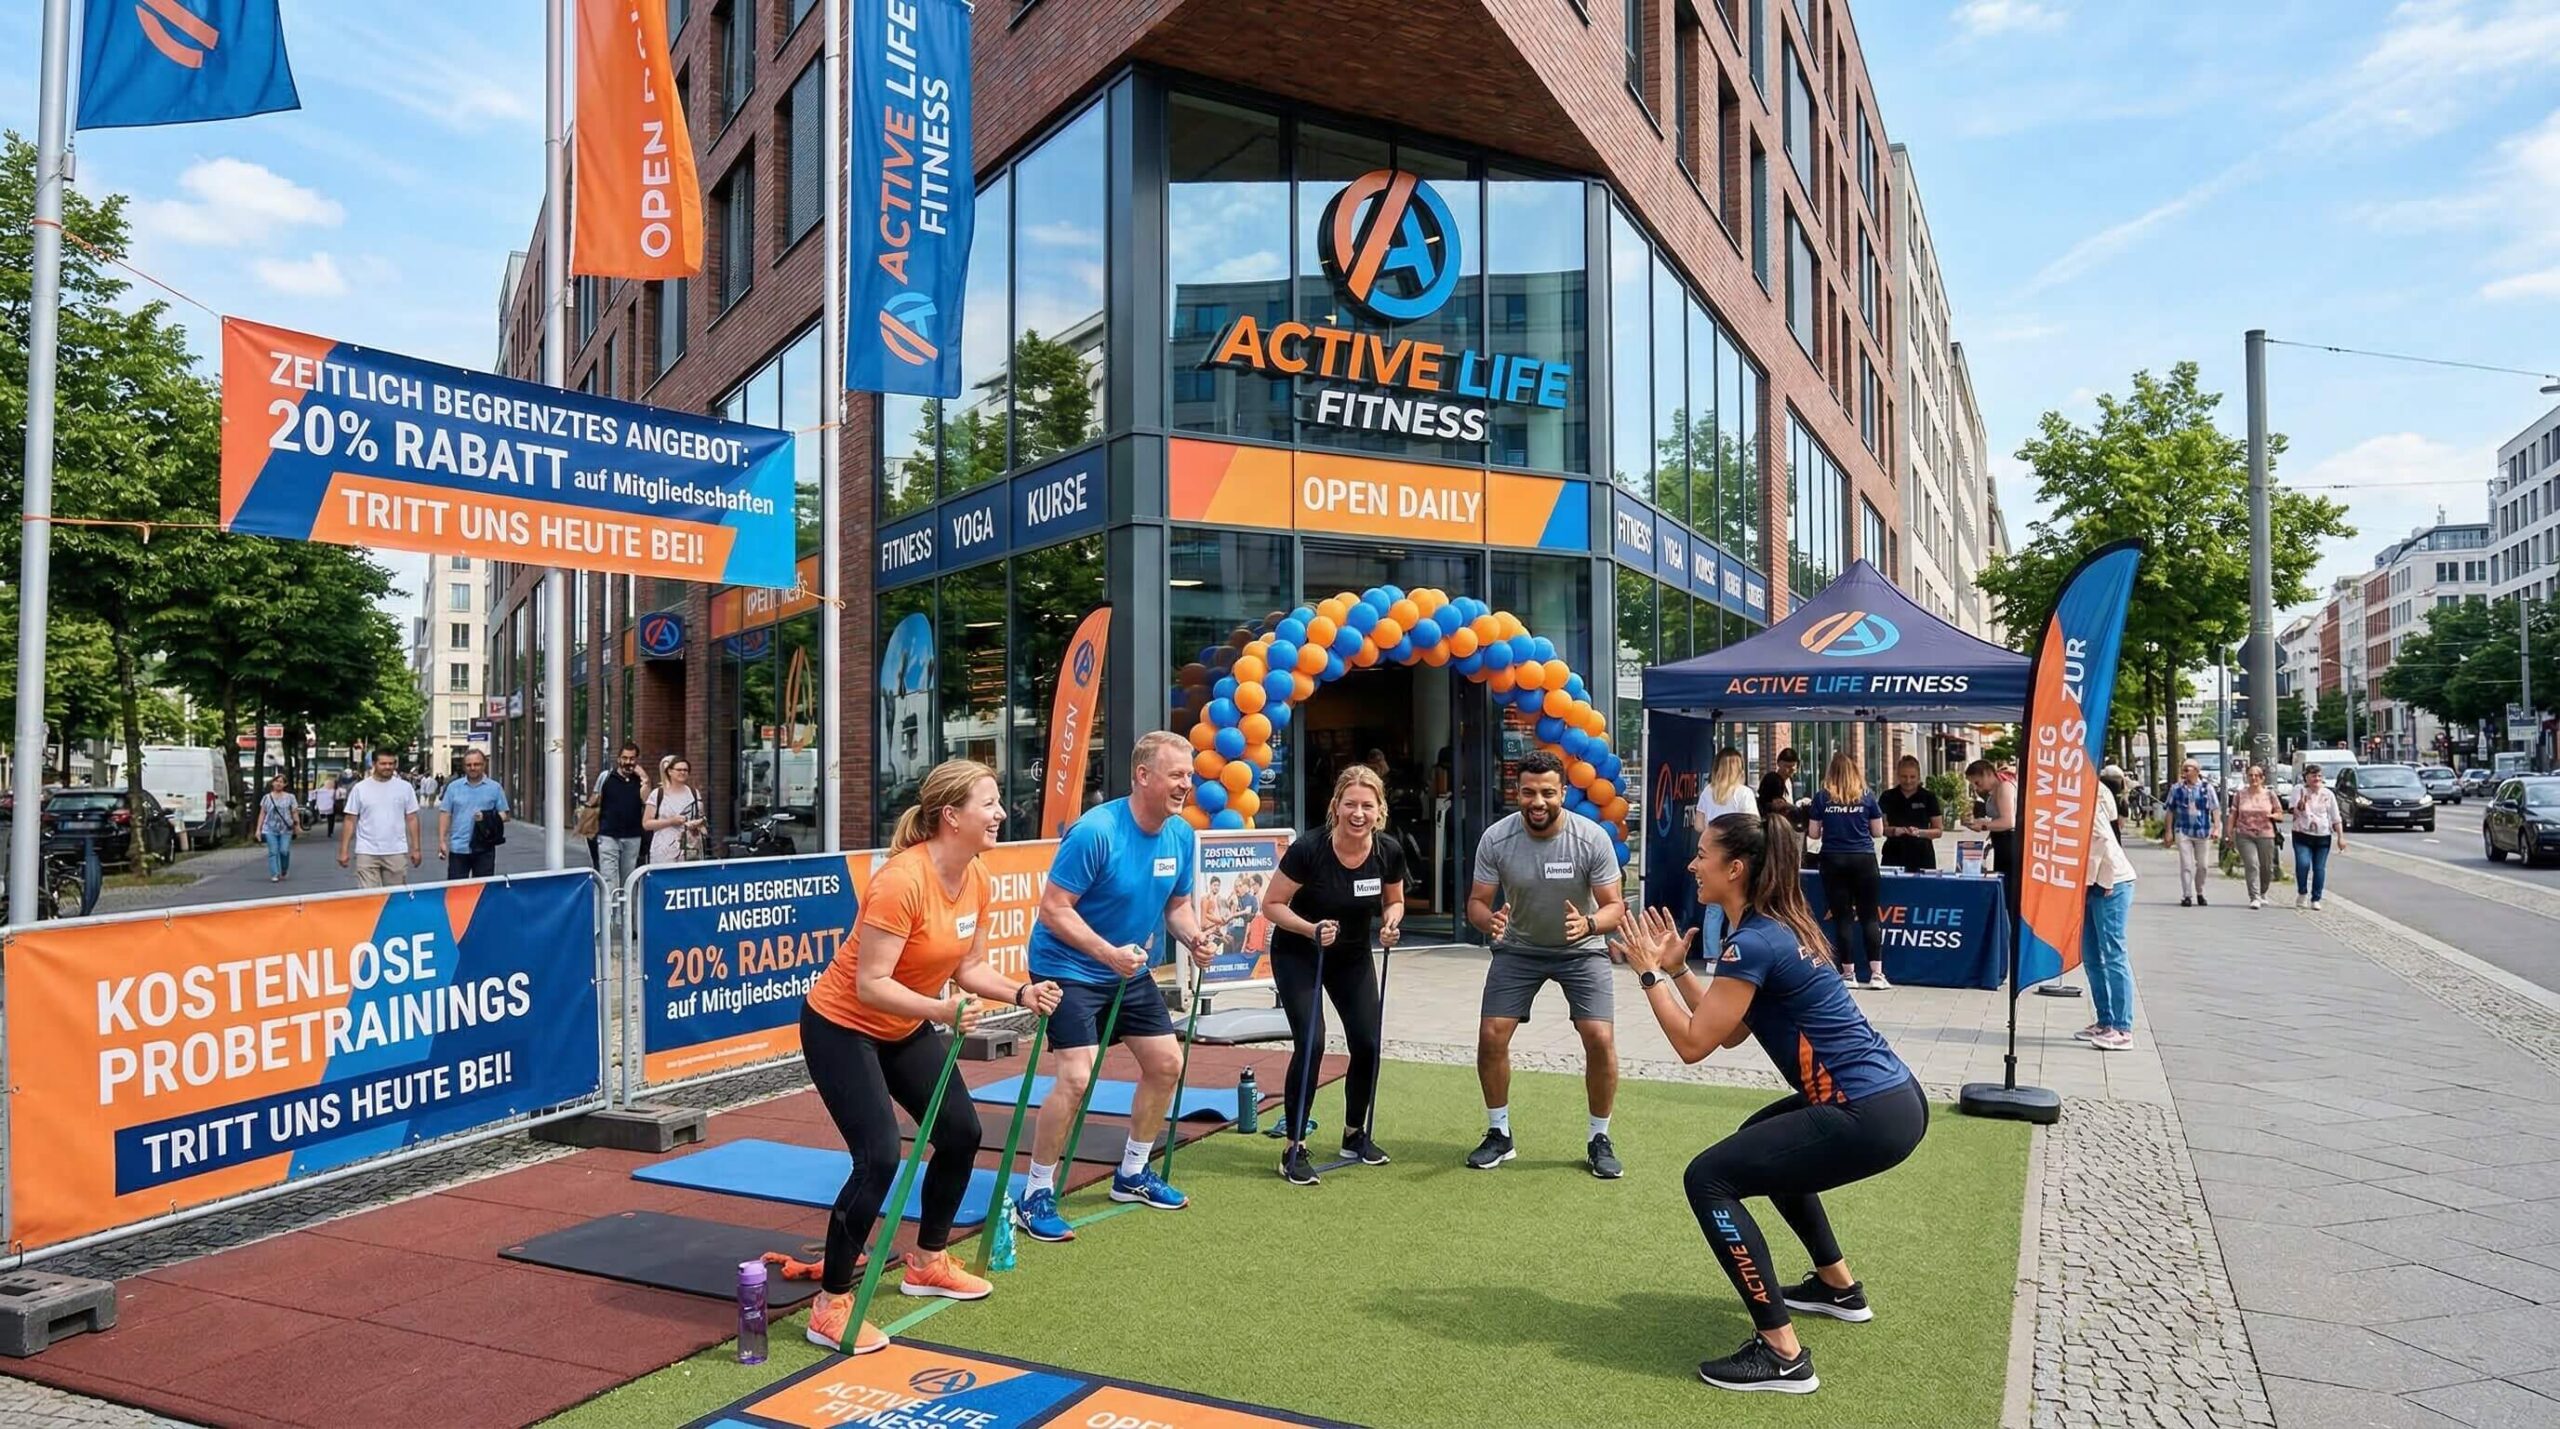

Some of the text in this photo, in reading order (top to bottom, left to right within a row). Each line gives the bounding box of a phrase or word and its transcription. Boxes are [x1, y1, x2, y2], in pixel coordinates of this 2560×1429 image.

[879, 0, 916, 285] ACTIVE LIFE
[920, 75, 950, 235] FITNESS
[640, 120, 671, 258] OPEN
[1213, 315, 1572, 410] ACTIVE LIFE
[269, 351, 749, 468] ZEITLICH BEGRENZTES ANGEBOT:
[1316, 389, 1486, 442] FITNESS
[268, 399, 774, 515] 20% RABATT auf Mitgliedschaften
[340, 488, 704, 565] TRITT UNS HEUTE BEI!
[882, 472, 1088, 572] FITNESS YOGA KURSE
[1303, 476, 1482, 523] OPEN DAILY
[1617, 510, 1652, 555] FITNESS
[1663, 535, 1684, 571] YOGA
[1725, 675, 1969, 695] ACTIVE LIFE FITNESS
[2050, 637, 2088, 890] FITNESS ZUR
[2031, 724, 2058, 884] DEIN WEG
[665, 874, 840, 911] ZEITLICH BEGRENZTES
[717, 904, 797, 932] ANGEBOT:
[988, 908, 1025, 941] ZUR
[990, 872, 1031, 903] DEIN
[1911, 906, 1964, 926] LIFE
[667, 927, 845, 988] 20% RABATT
[1880, 928, 1962, 948] ITNESS
[97, 932, 437, 1036] KOSTENLOSE
[667, 991, 697, 1020] auf
[99, 972, 531, 1105] PROBETRAININGS
[142, 1050, 512, 1174] TRITT UNS HEUTE BEI!
[1712, 1208, 1770, 1304] ACTIVE LIFE
[814, 1381, 999, 1429] ACTIVE LIFE
